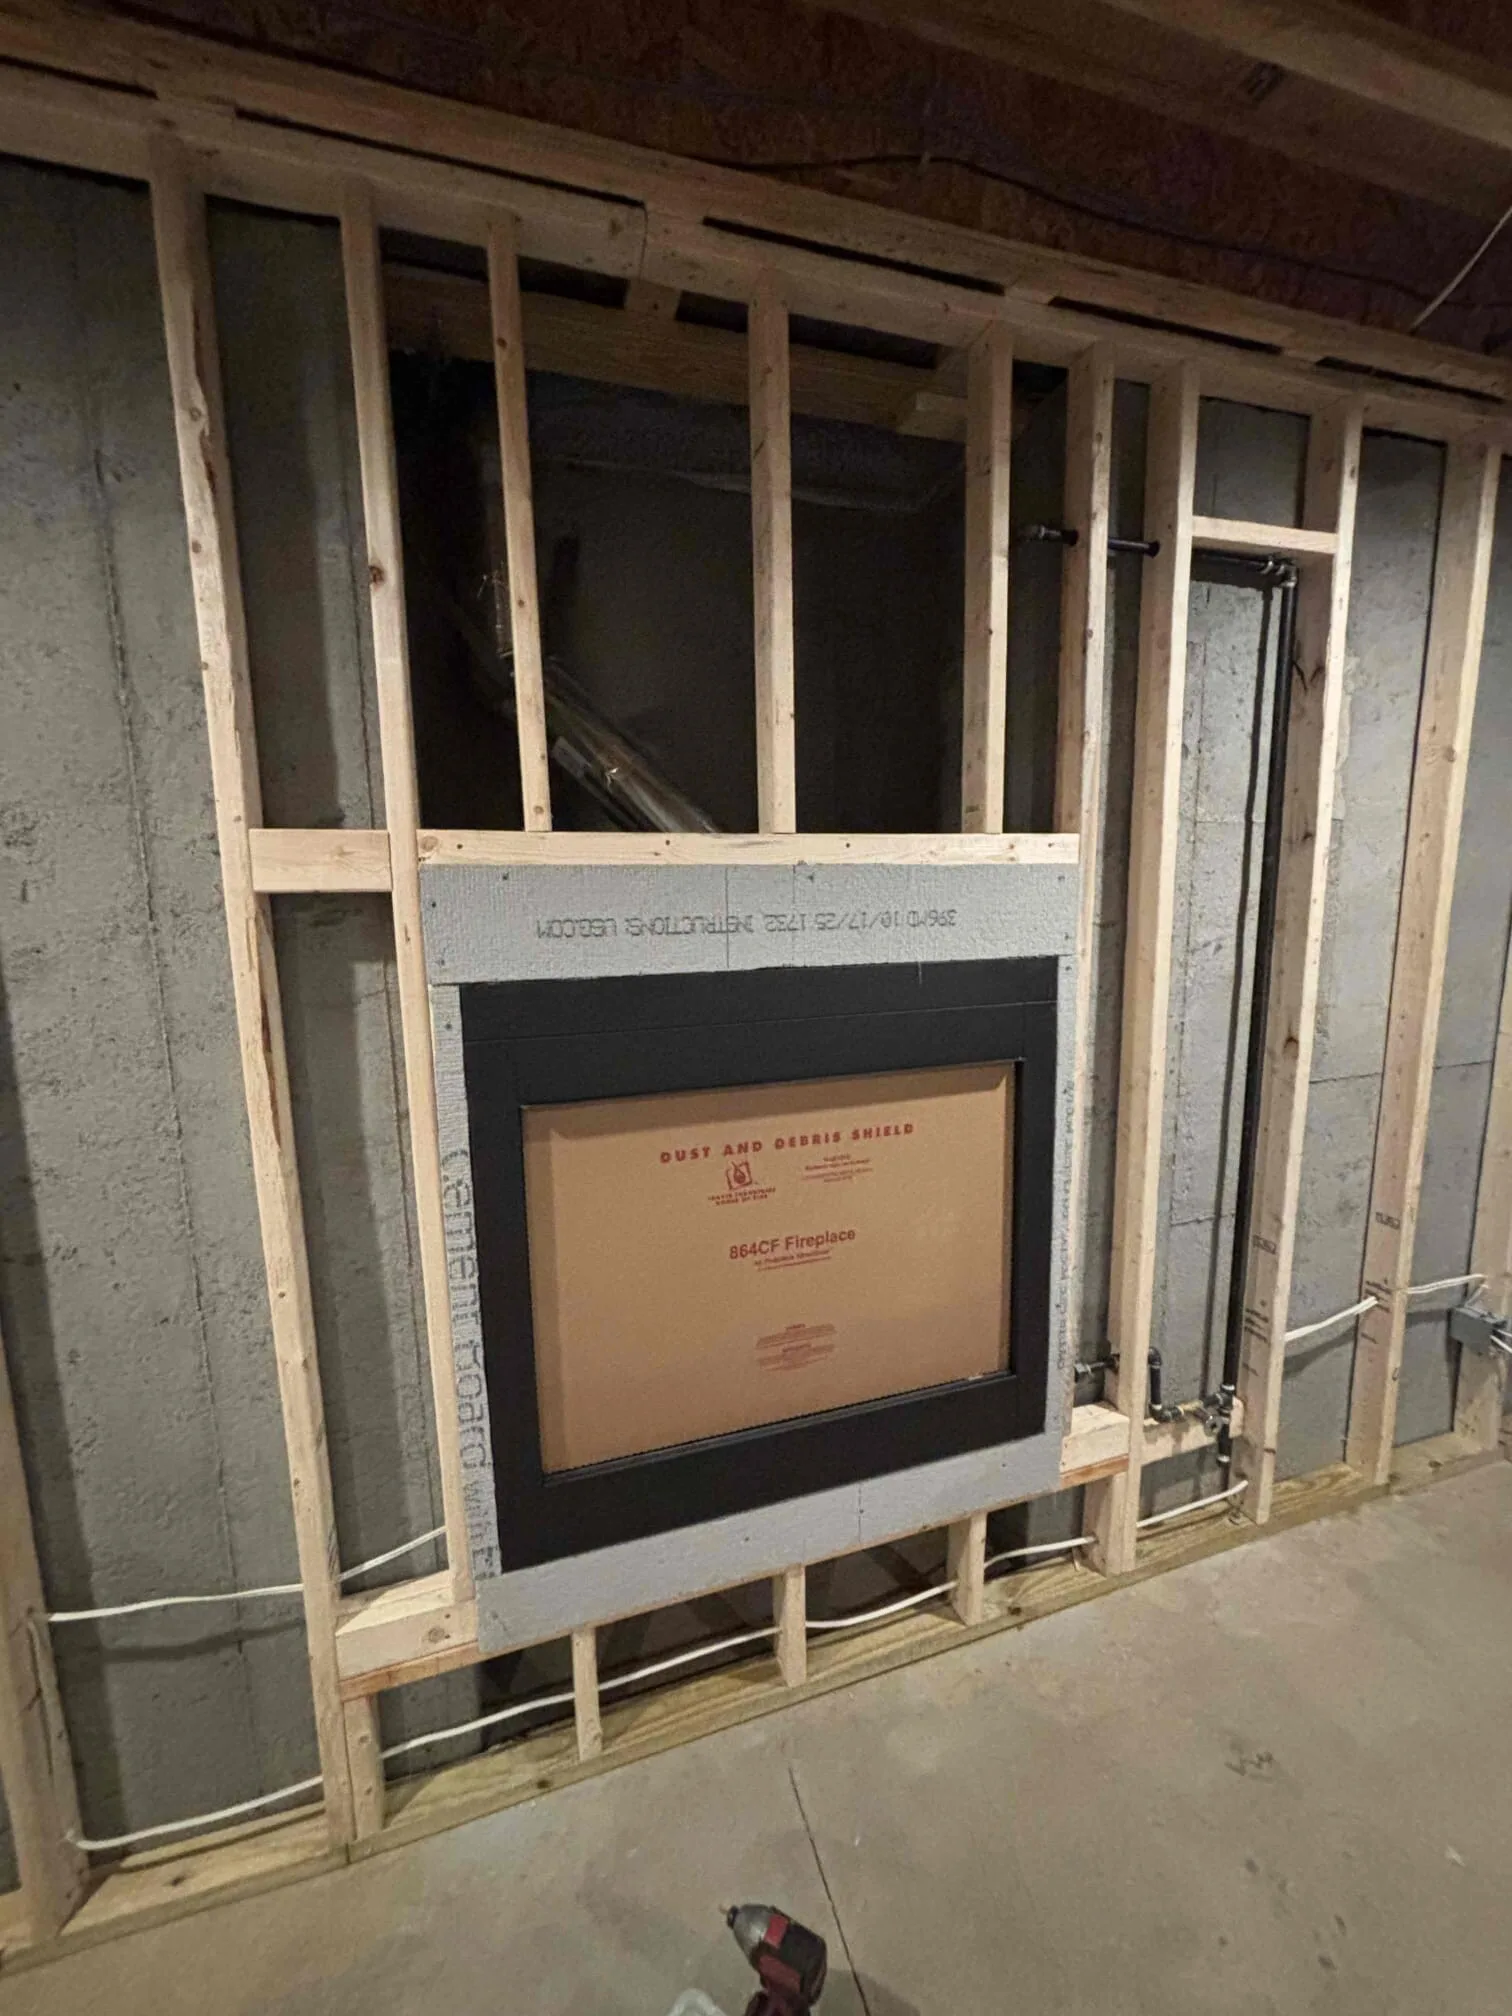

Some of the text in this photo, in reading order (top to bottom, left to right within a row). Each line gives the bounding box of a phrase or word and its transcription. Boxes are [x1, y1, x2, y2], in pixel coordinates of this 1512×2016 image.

[536, 917, 618, 939] USG.COM
[624, 914, 755, 937] INSTRUCTIONS:
[763, 912, 808, 932] 1732
[814, 910, 900, 931] 10/17/25
[659, 1122, 915, 1164] DUST AND DEBRIS SHIELD
[728, 1229, 856, 1260] 864CF Fireplace
